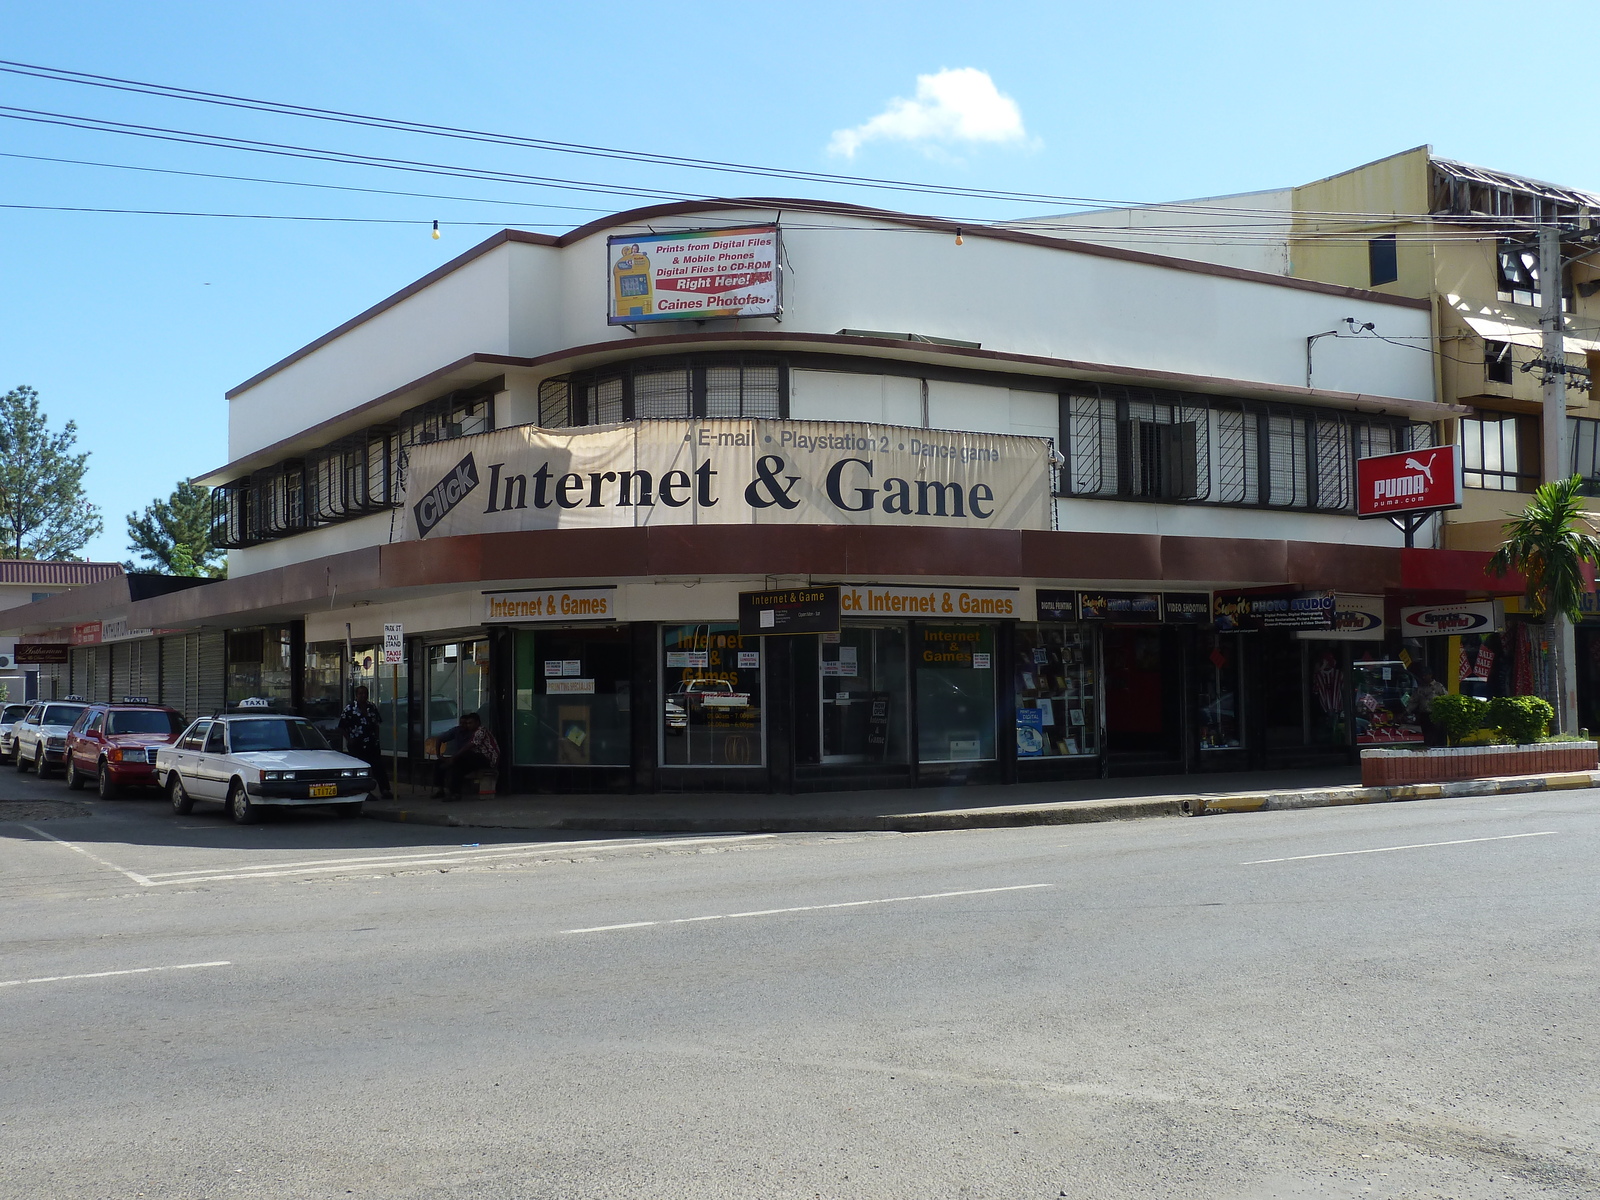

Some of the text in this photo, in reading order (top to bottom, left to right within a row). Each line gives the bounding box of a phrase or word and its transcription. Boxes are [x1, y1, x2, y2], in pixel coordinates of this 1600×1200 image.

[656, 245, 684, 253] Prints
[713, 240, 744, 250] Digital
[683, 255, 715, 263] Mobile
[718, 252, 754, 260] Phones
[656, 268, 688, 277] Digital
[730, 261, 771, 270] CD-ROM
[676, 275, 750, 290] Right Here!
[658, 294, 770, 310] Caines Photofas
[699, 428, 998, 464] E-mail Playstation 2 Dance game
[483, 454, 994, 519] Internet & Game
[1374, 474, 1424, 499] PUMA
[420, 464, 475, 528] Click
[1374, 496, 1424, 508] puma.com
[752, 592, 825, 605] Internet & Game
[868, 590, 936, 612] Internet
[942, 592, 954, 613] &
[959, 592, 1013, 614] Games
[1107, 598, 1130, 612] PHOTO
[1132, 598, 1158, 612] STUDIO
[1252, 600, 1290, 612] PHOTO
[1290, 597, 1332, 610] STUDIO
[490, 594, 607, 617] Internet & Games
[1040, 601, 1055, 610] DIGITAL
[1166, 602, 1207, 613] VIDEO SHOOTING
[1424, 612, 1460, 624] Sports
[1438, 618, 1468, 629] World
[678, 630, 744, 648] Internet
[924, 630, 981, 641] Internet
[950, 642, 960, 650] &
[710, 650, 720, 666] &
[923, 650, 972, 662] Games
[1479, 650, 1494, 659] SALE
[1476, 658, 1490, 668] SALE
[682, 667, 738, 686] Games
[1474, 666, 1488, 676] SALE
